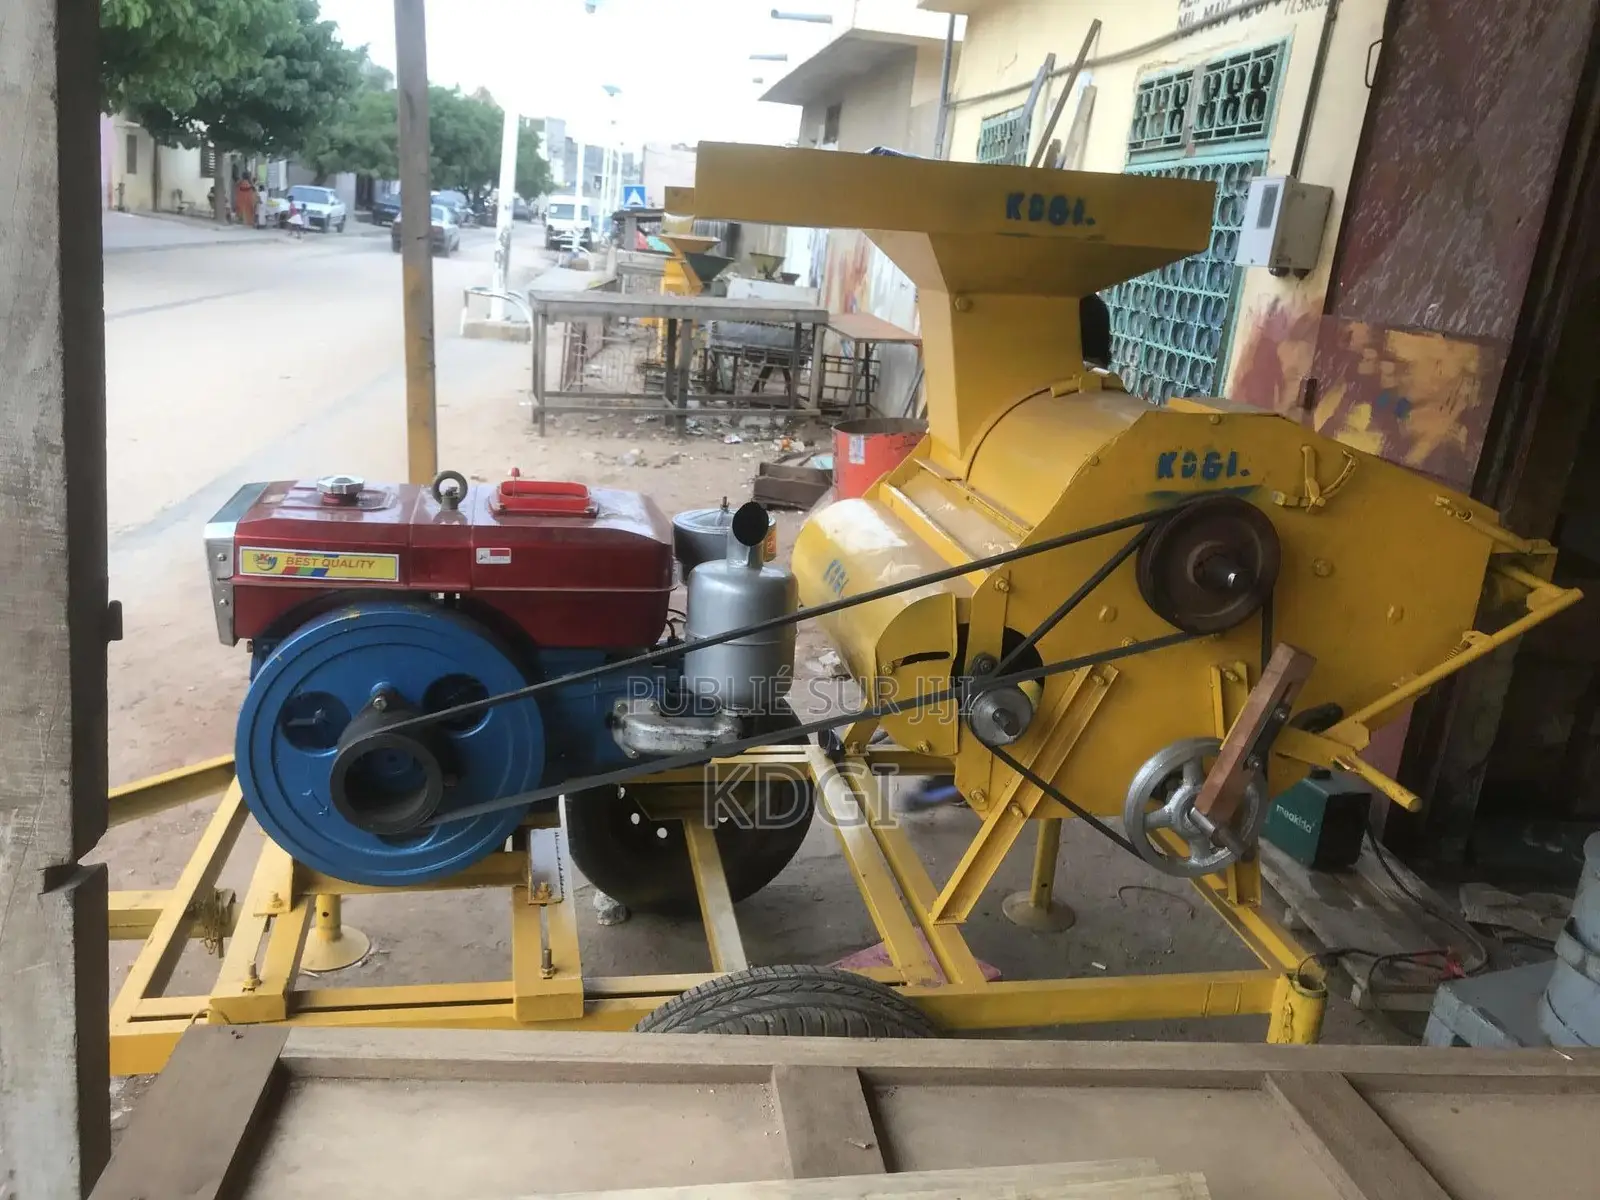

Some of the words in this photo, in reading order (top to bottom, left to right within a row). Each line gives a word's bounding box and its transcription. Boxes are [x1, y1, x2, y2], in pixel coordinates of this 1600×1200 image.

[1157, 450, 1251, 481] KDGI.
[286, 556, 316, 567] BEST
[321, 558, 375, 569] QUALITY
